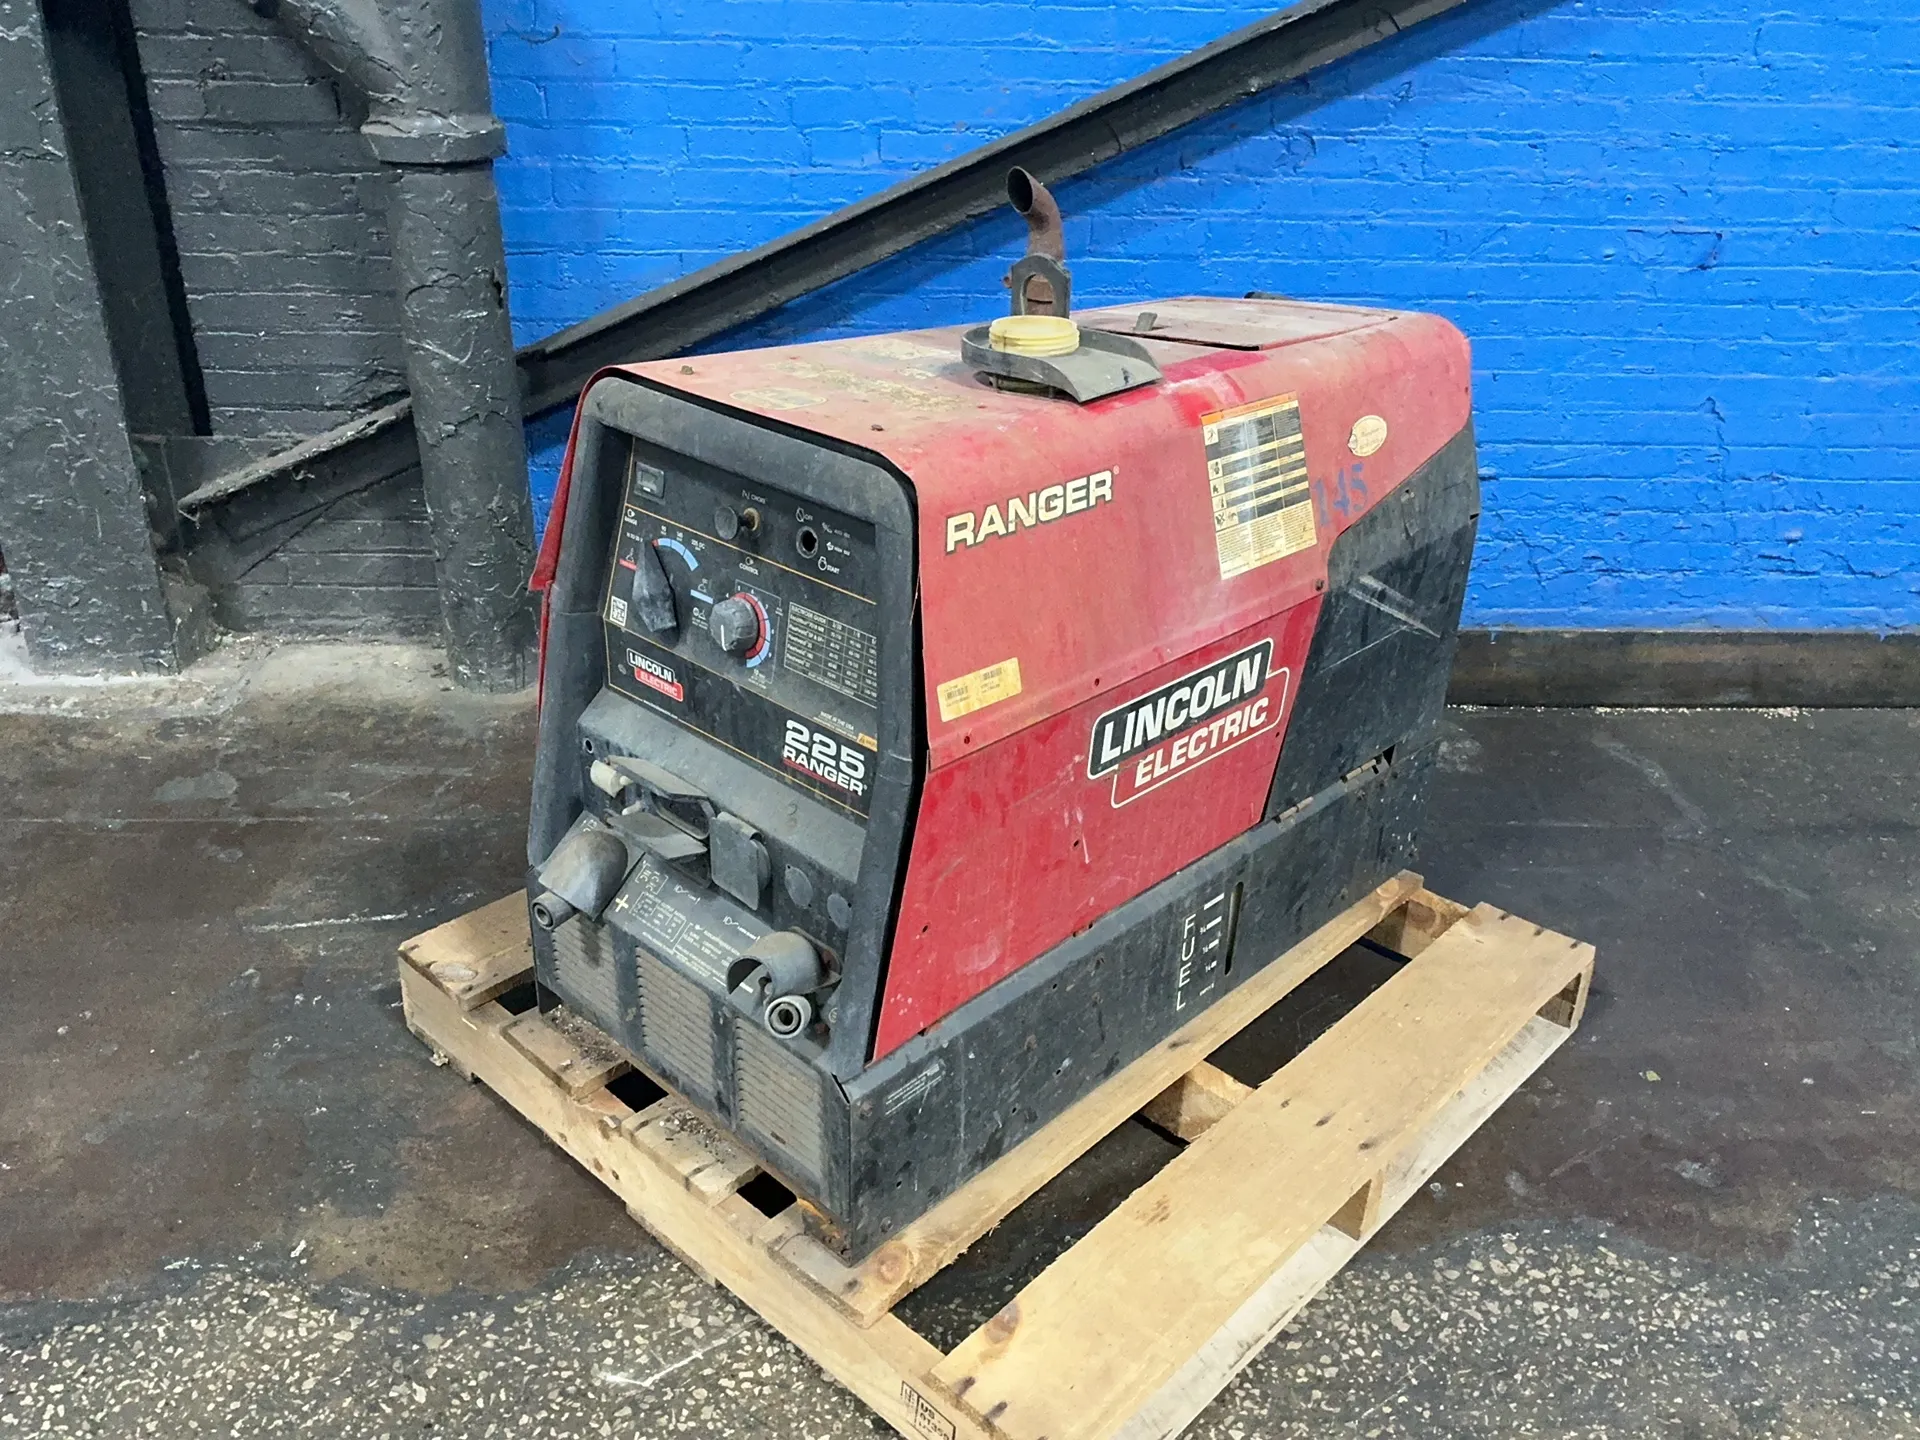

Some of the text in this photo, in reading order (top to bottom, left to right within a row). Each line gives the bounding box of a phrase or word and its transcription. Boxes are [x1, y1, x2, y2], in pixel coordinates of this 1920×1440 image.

[945, 469, 1114, 554] RANGER
[1314, 464, 1368, 529] 145
[629, 651, 673, 683] LINCOLN
[640, 670, 679, 697] ELECTRIC
[1099, 651, 1263, 765] LINCOLN
[782, 744, 865, 797] RANGER
[784, 719, 866, 780] 225
[1134, 696, 1270, 789] ELECTRIC
[1176, 913, 1197, 1012] FUEL
